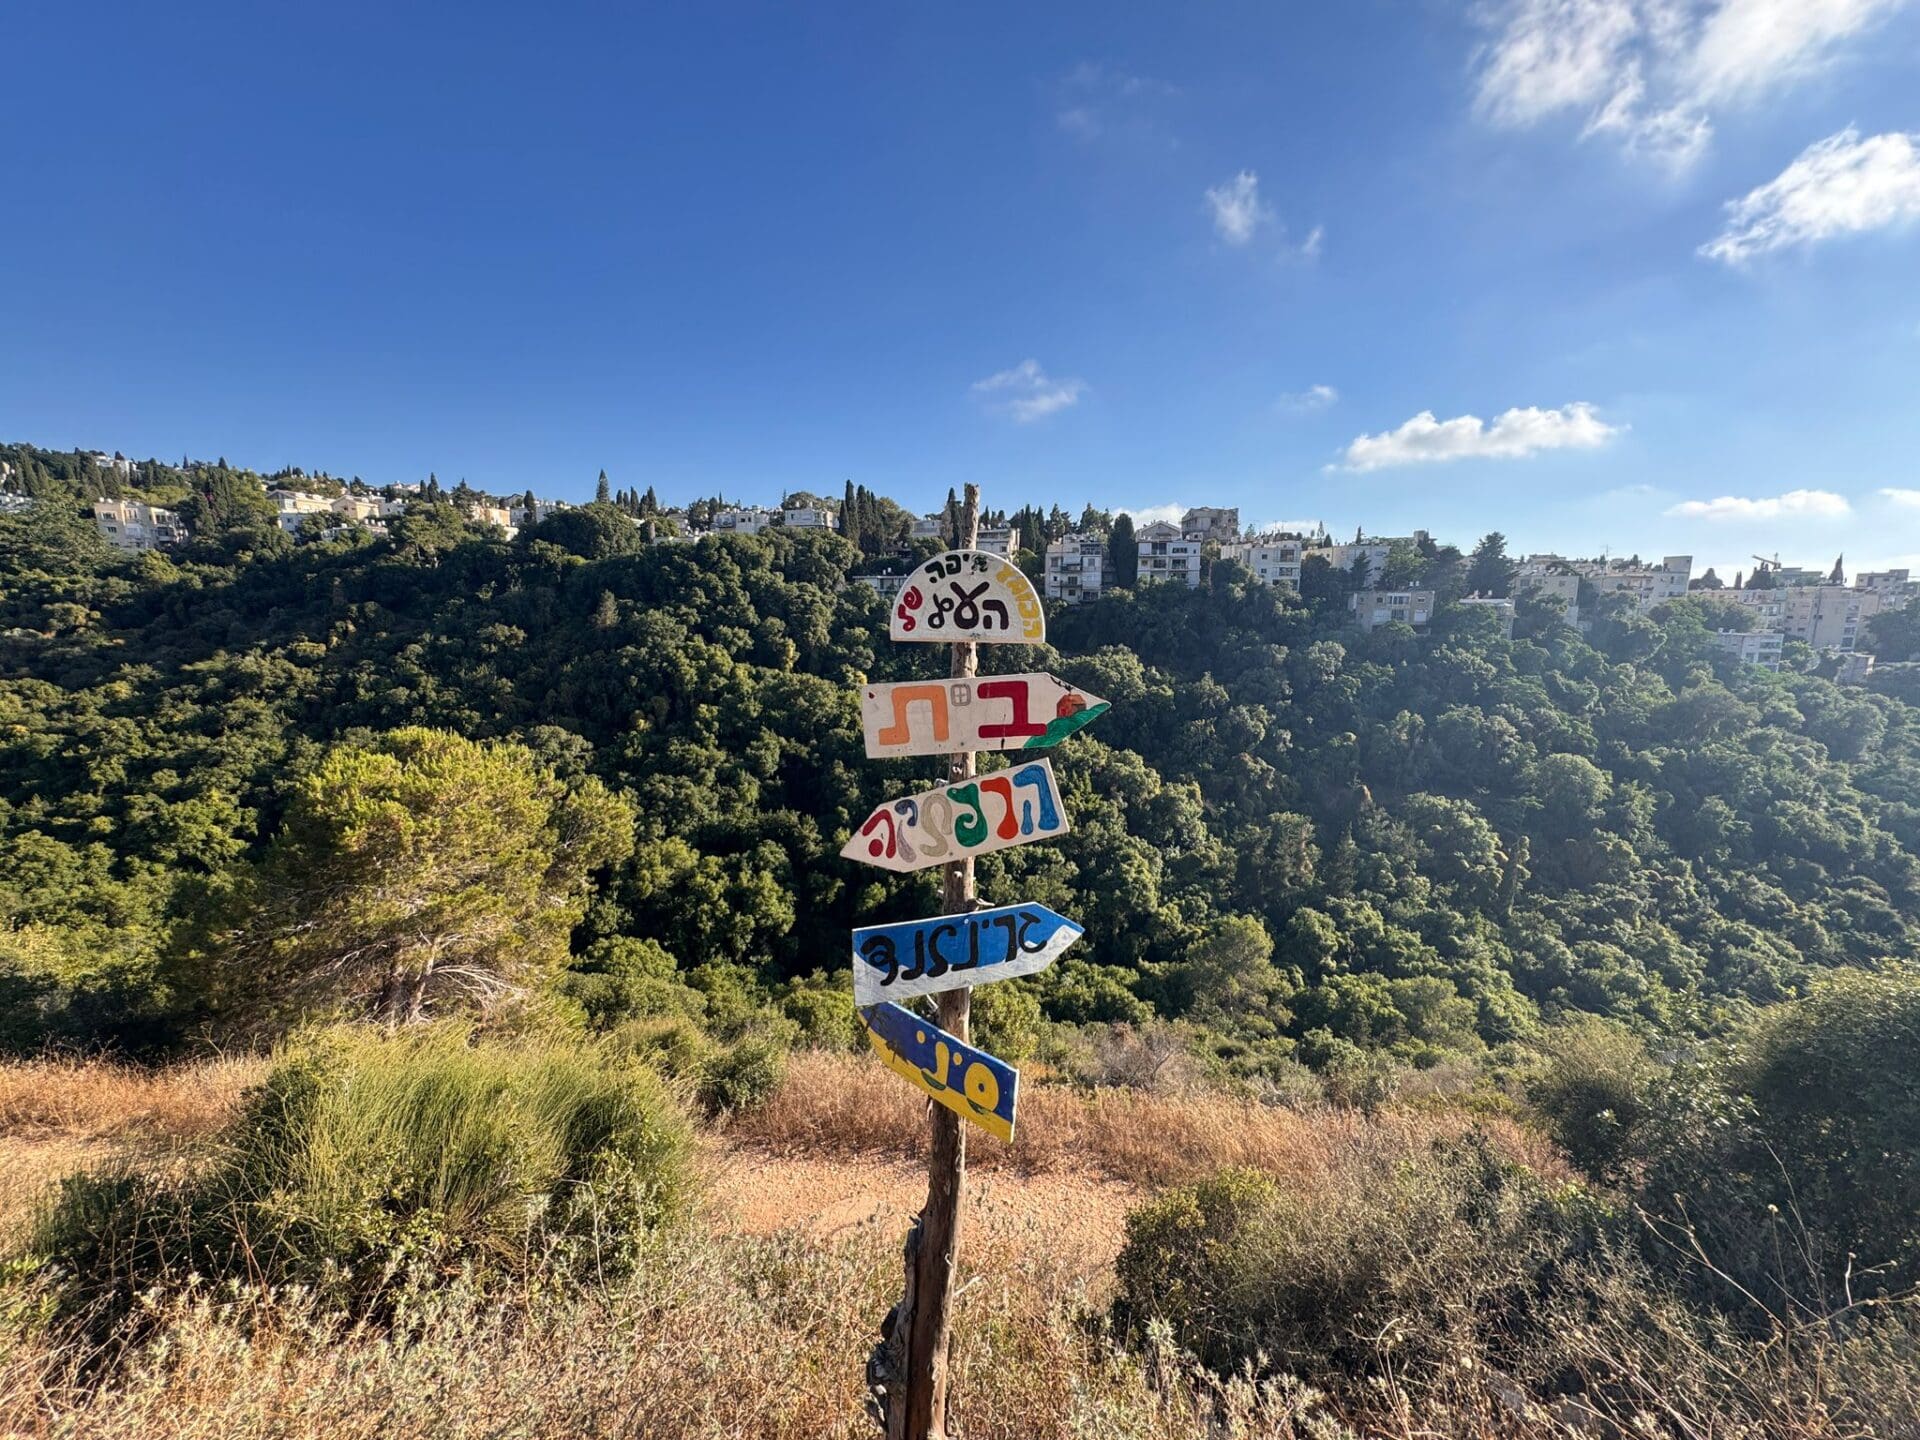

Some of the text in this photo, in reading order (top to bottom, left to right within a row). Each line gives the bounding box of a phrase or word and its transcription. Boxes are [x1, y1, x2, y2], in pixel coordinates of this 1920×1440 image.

[898, 586, 923, 631] של
[860, 911, 1047, 986] גרינלנד
[915, 1030, 1000, 1113] סיני
